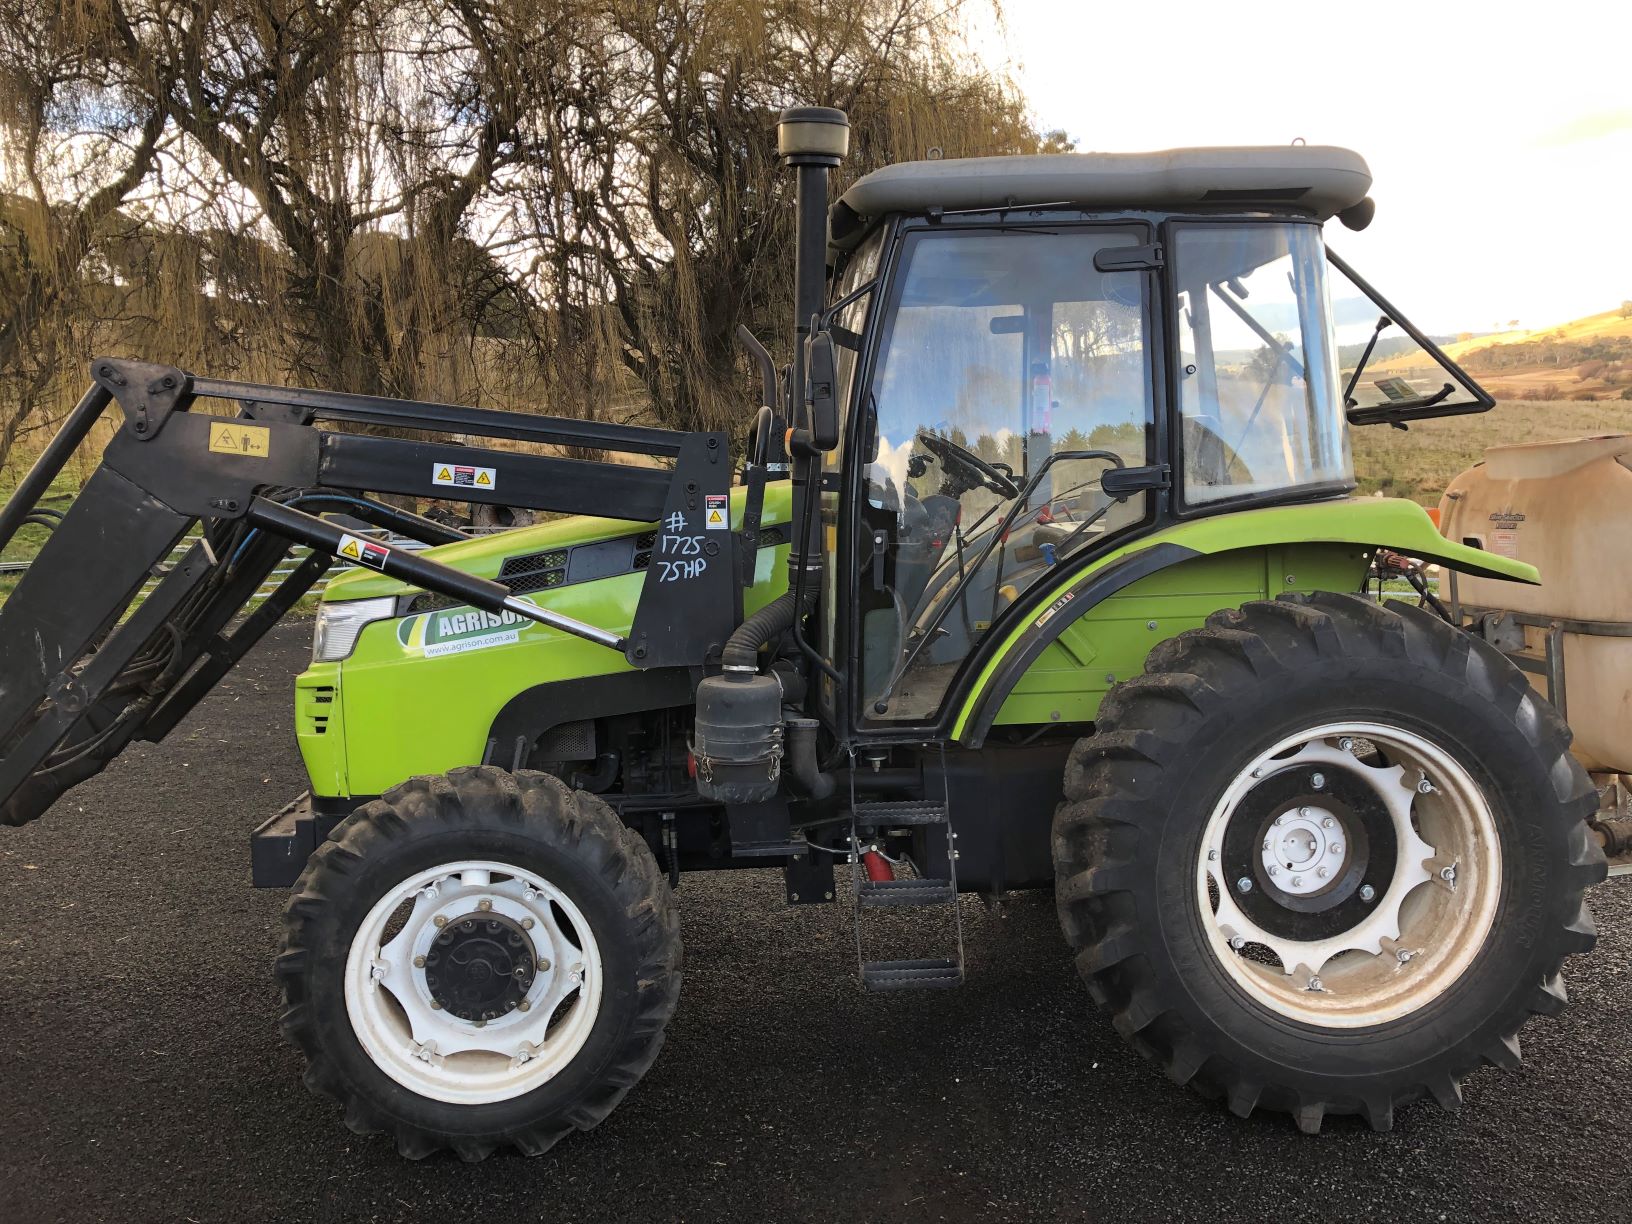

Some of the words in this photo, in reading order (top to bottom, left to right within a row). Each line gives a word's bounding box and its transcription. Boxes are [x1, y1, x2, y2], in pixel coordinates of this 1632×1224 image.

[664, 511, 688, 533] #
[661, 534, 706, 555] 1725
[656, 557, 707, 583] 75HP
[426, 633, 516, 656] www.agrison.com.au
